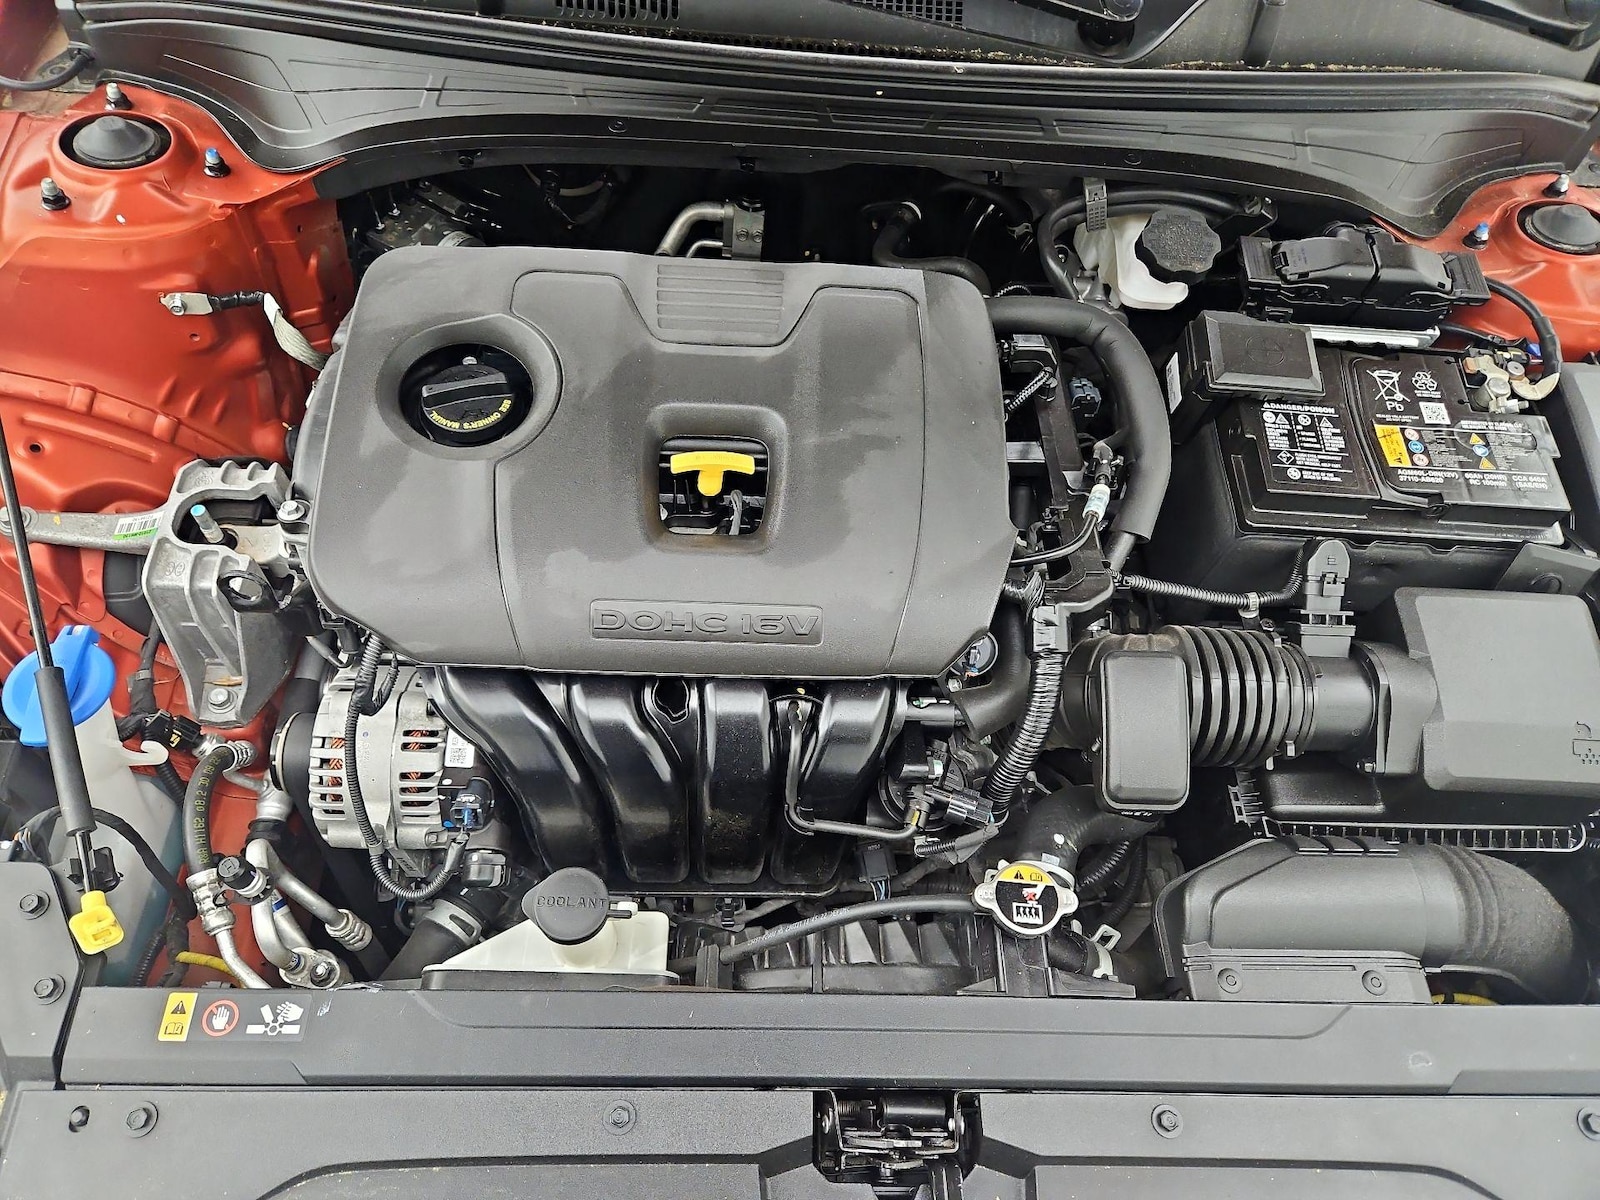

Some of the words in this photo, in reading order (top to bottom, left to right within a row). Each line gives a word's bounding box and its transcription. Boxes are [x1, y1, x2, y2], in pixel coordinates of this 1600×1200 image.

[499, 400, 512, 412] SEE
[1270, 402, 1335, 414] DANGER/POISON
[1386, 401, 1404, 411] Pb
[430, 410, 460, 429] MANUAL
[463, 412, 501, 430] OWNER'S
[594, 609, 727, 633] DOHC
[741, 613, 818, 636] 16V
[537, 896, 607, 909] COOLANT
